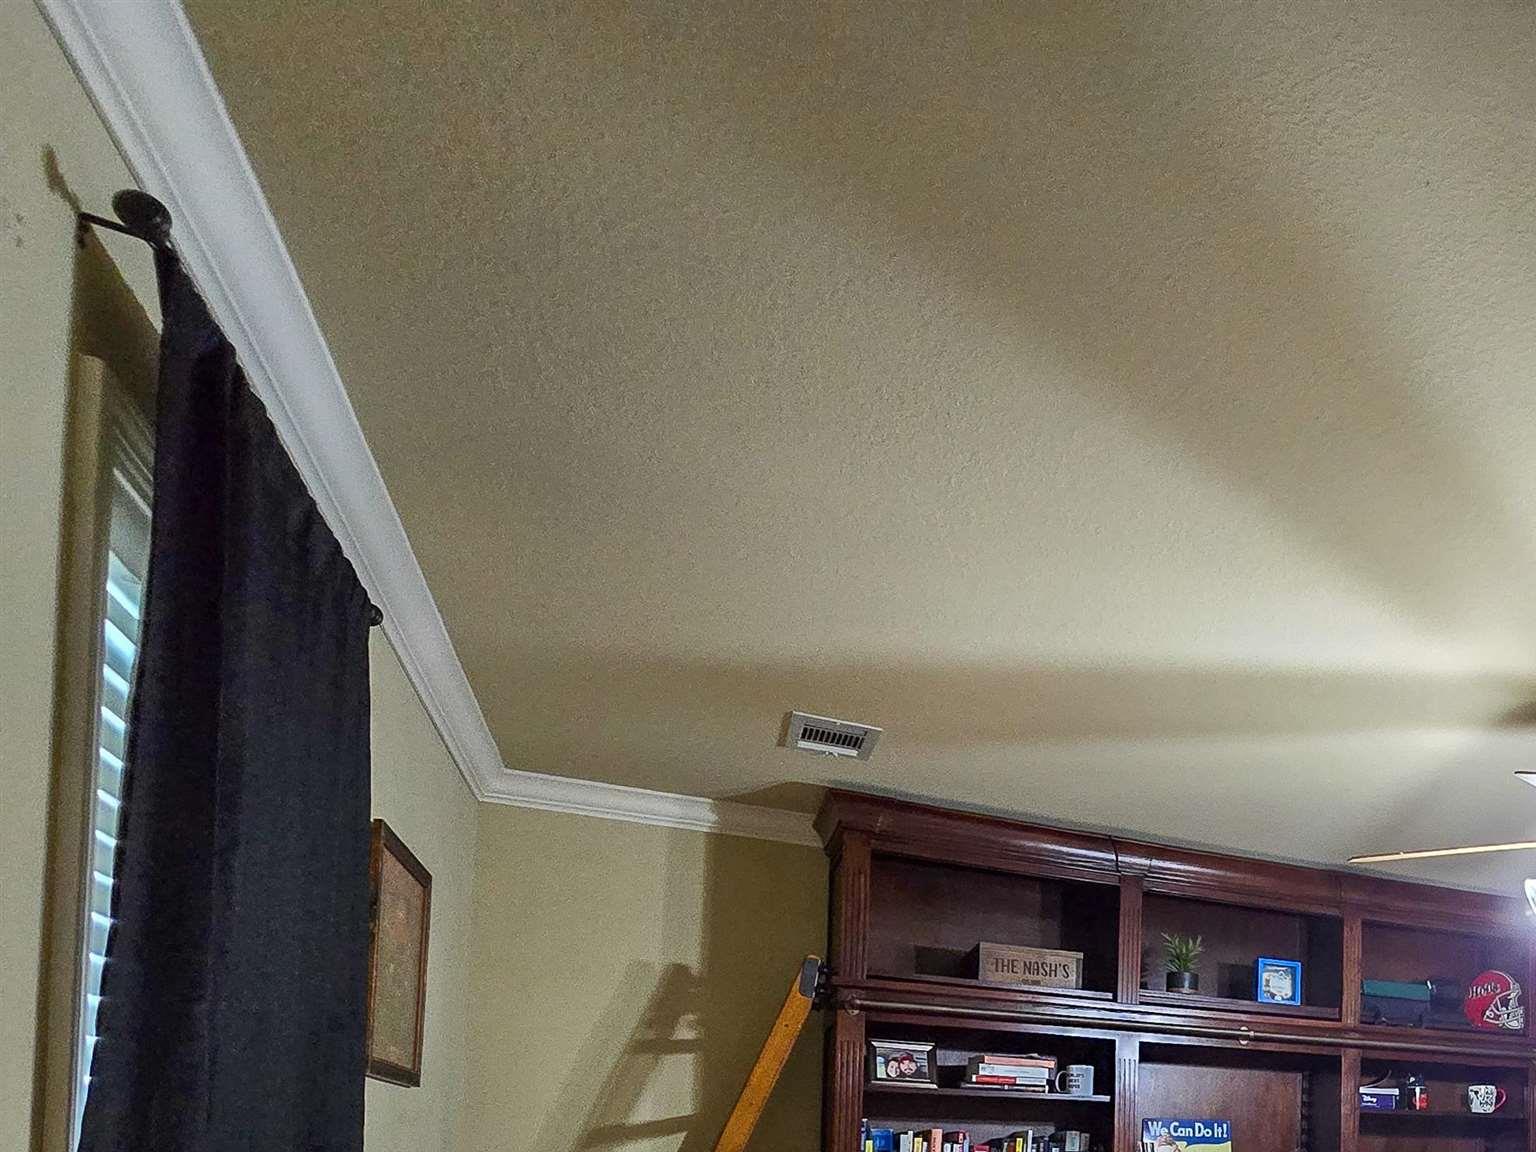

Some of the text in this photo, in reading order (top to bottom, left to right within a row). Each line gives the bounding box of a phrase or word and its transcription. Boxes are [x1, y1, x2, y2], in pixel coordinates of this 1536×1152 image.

[993, 957, 1070, 979] THE NASH'S
[1147, 1121, 1228, 1138] We Can Do It!
